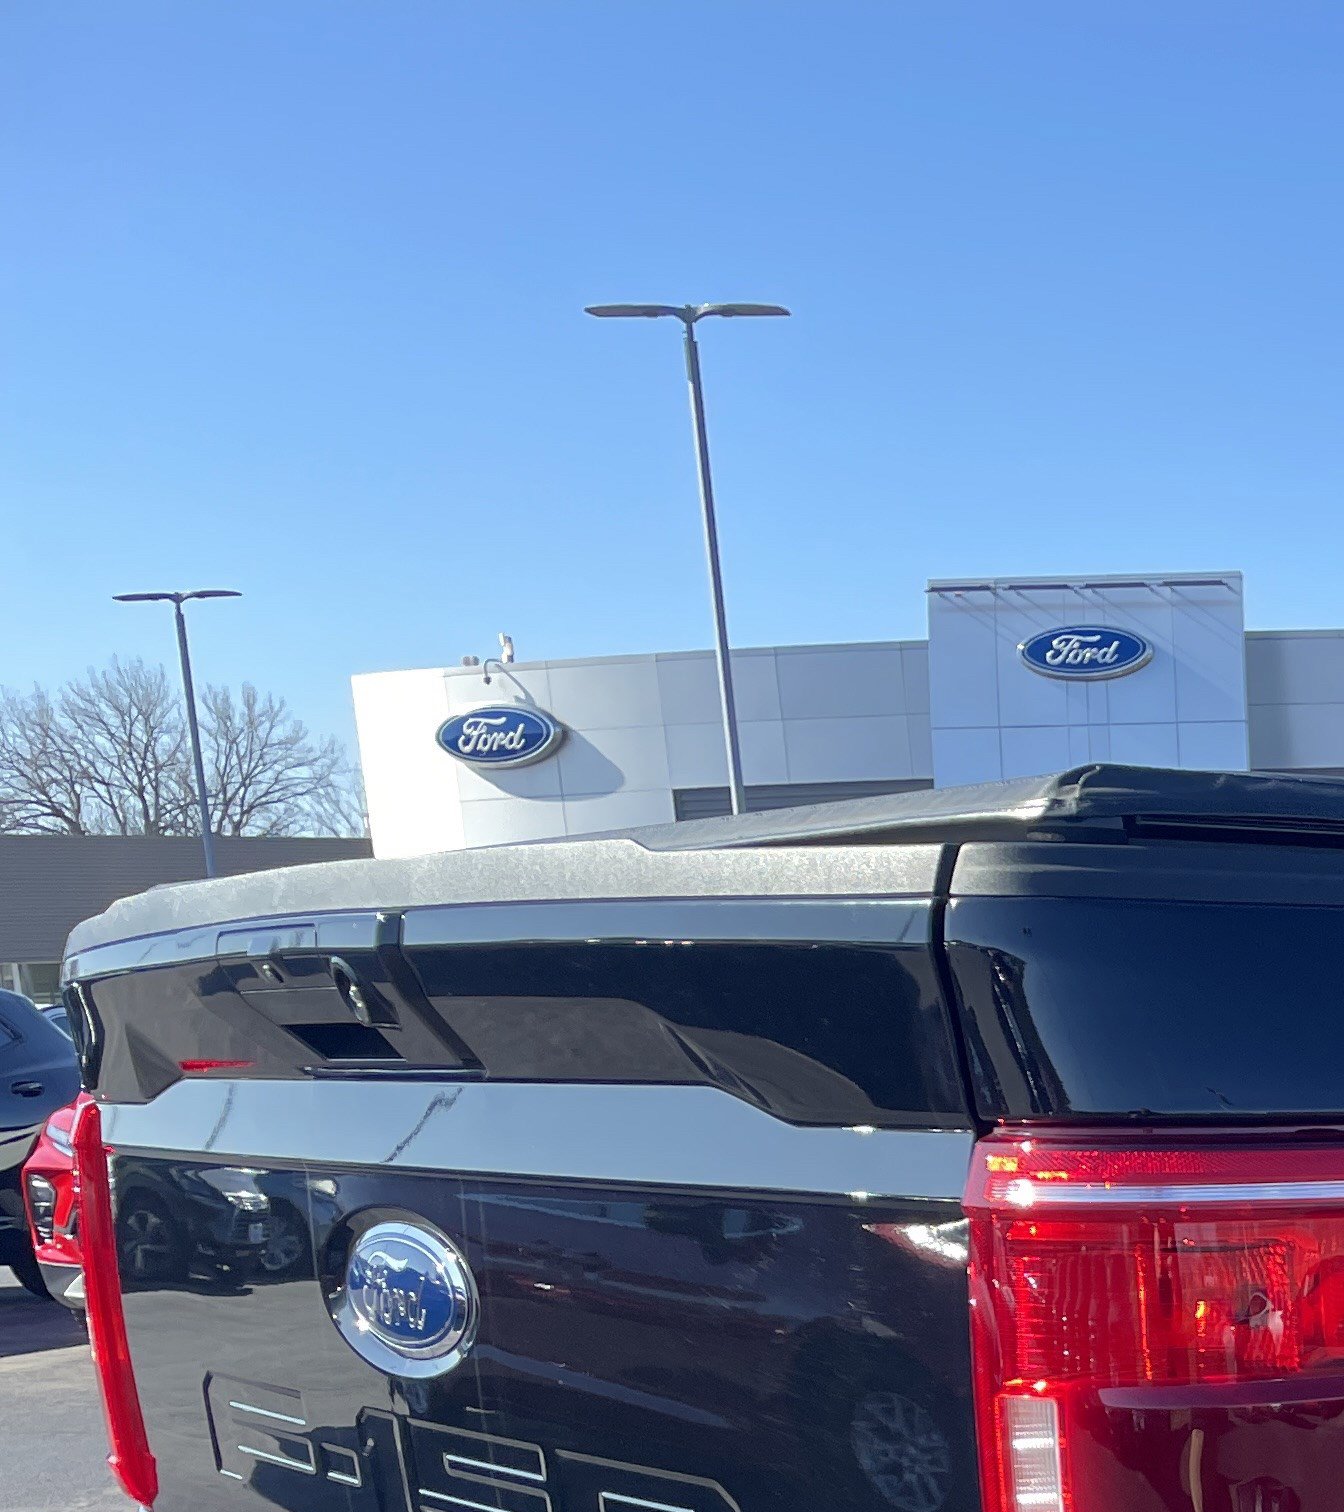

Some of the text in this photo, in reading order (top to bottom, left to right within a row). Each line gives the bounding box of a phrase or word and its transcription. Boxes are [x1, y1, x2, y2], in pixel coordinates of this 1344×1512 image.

[1045, 634, 1120, 665] Ford
[458, 716, 526, 754] Ford
[362, 1250, 428, 1332] Ford
